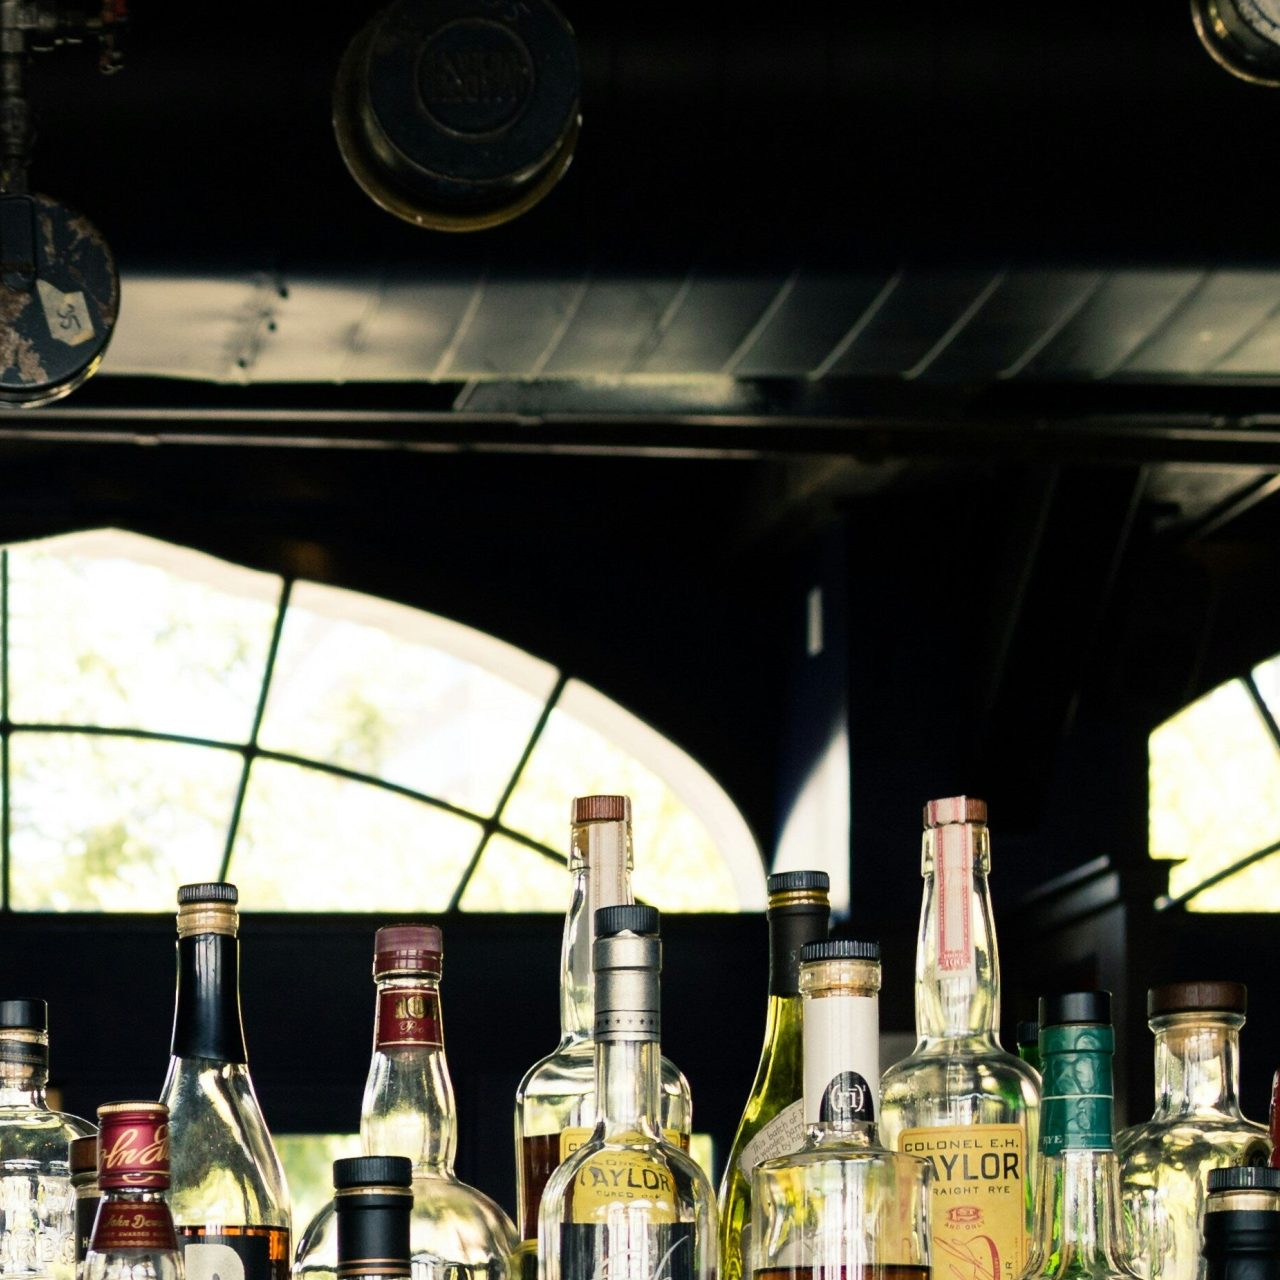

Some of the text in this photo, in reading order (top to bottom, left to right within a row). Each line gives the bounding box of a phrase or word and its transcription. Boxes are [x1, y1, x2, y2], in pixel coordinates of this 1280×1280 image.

[753, 1114, 799, 1154] This batch of
[905, 1139, 1019, 1153] COLONEL E.H.
[930, 1153, 1020, 1182] AYLOR
[988, 1186, 1010, 1194] RYE
[944, 1222, 961, 1231] AND
